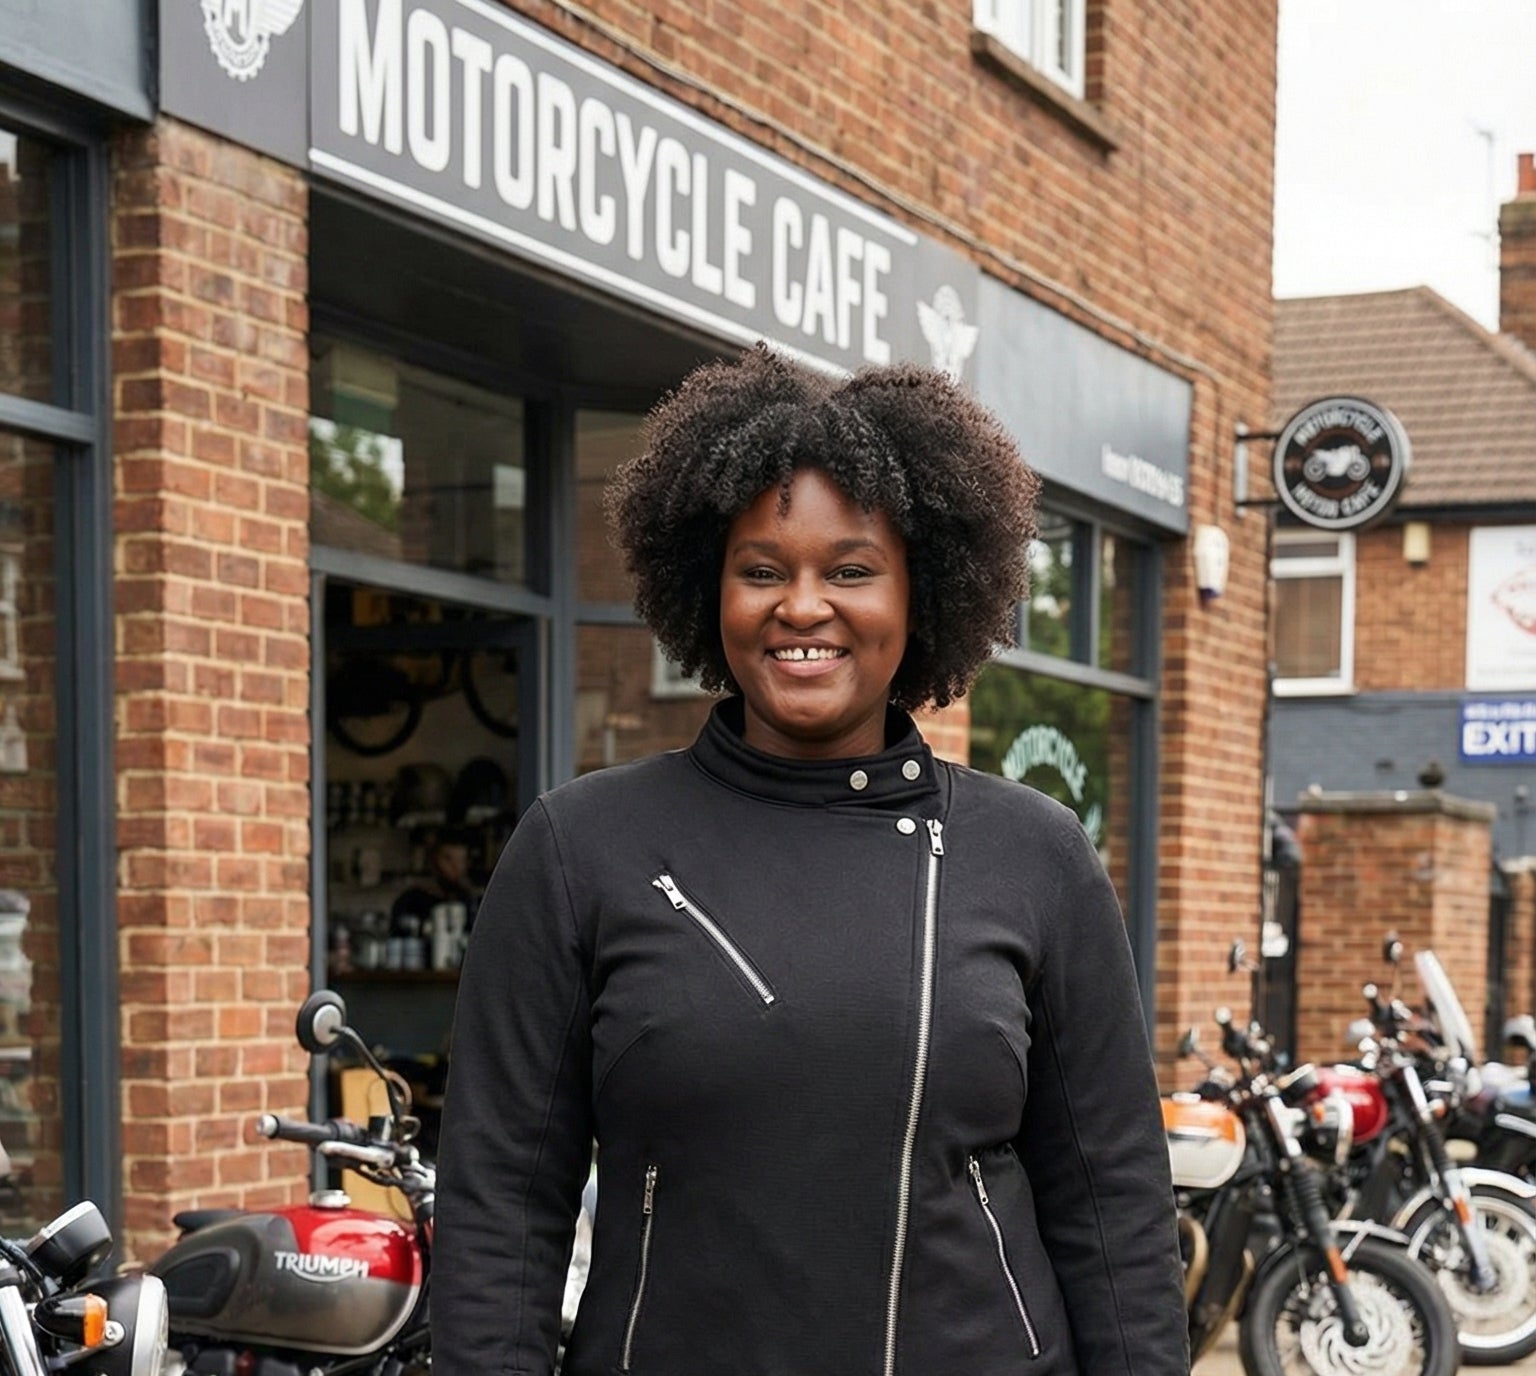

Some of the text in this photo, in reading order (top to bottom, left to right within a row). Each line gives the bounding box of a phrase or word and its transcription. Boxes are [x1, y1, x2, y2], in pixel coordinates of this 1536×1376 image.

[339, 0, 891, 366] MOTORCYCLE CAFE
[1463, 721, 1536, 756] EXIT
[274, 1251, 370, 1281] TRIUMPH
